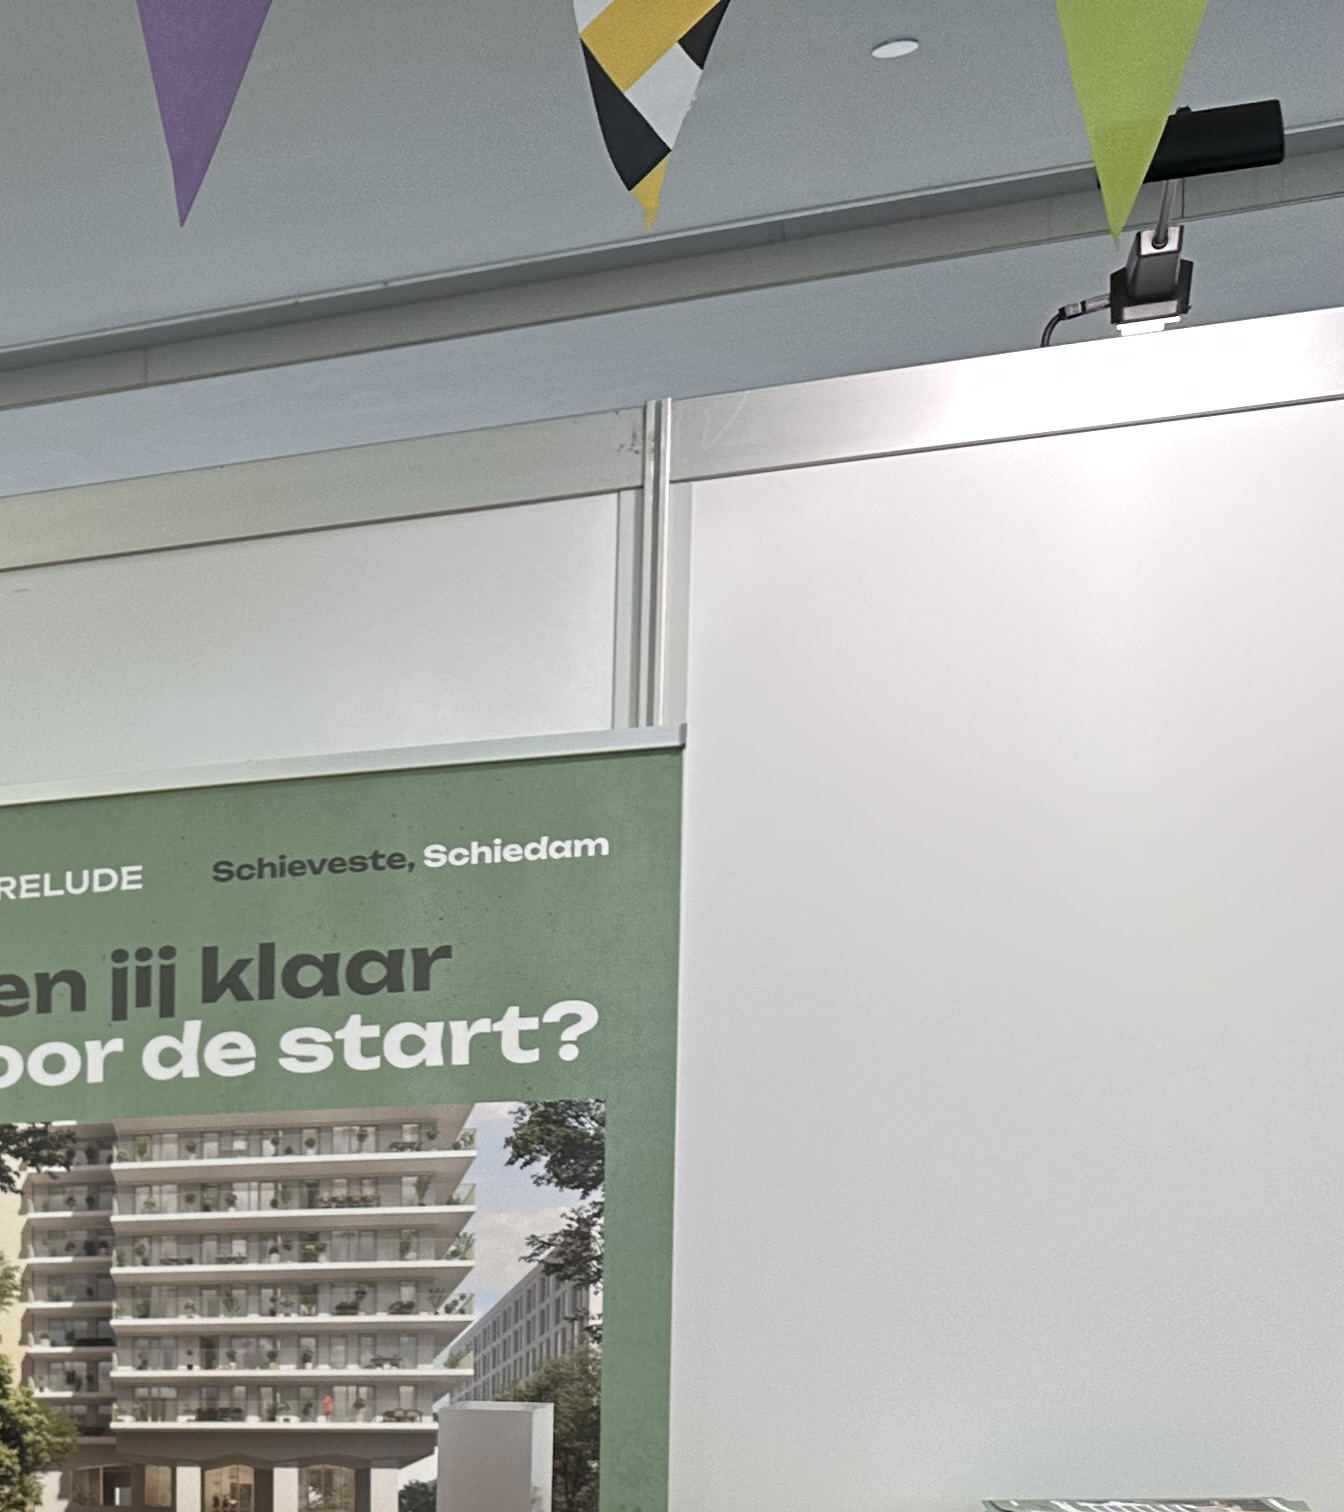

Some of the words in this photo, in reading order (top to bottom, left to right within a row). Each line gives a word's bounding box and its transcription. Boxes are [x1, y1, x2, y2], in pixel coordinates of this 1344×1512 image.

[211, 848, 416, 883] Schieveste,
[422, 834, 610, 868] Schiedam
[110, 945, 177, 1022] jij
[201, 942, 453, 1005] klaar
[142, 1019, 256, 1080] de
[278, 1000, 599, 1074] start?
